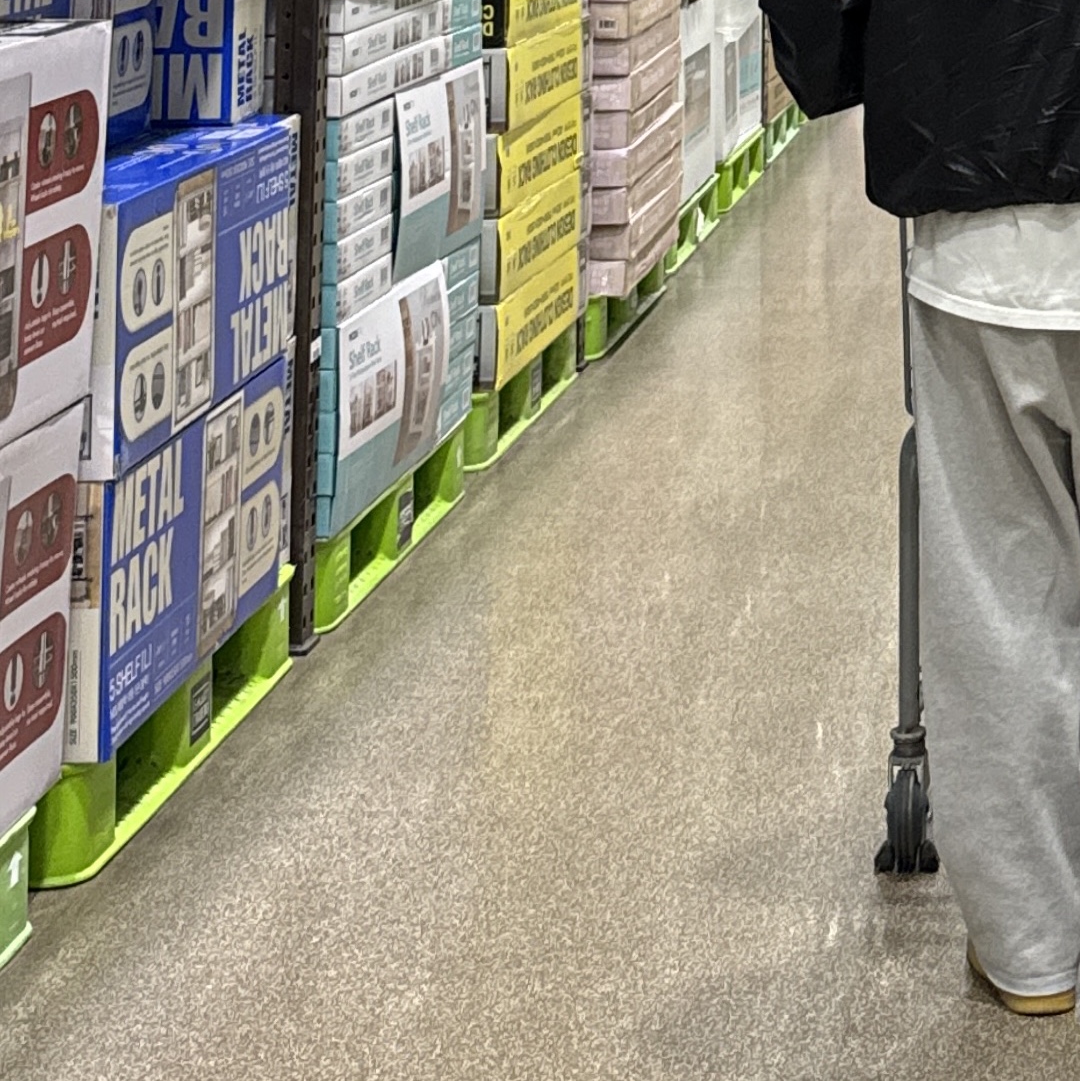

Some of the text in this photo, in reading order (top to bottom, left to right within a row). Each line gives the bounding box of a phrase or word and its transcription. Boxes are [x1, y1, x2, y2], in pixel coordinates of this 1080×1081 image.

[237, 27, 247, 107] METAL
[245, 34, 254, 103] RACK
[239, 207, 288, 303] RACK
[230, 281, 288, 385] METAL
[349, 335, 381, 370] Shelf Rack
[111, 438, 184, 567] METAL
[109, 525, 175, 658] RACK
